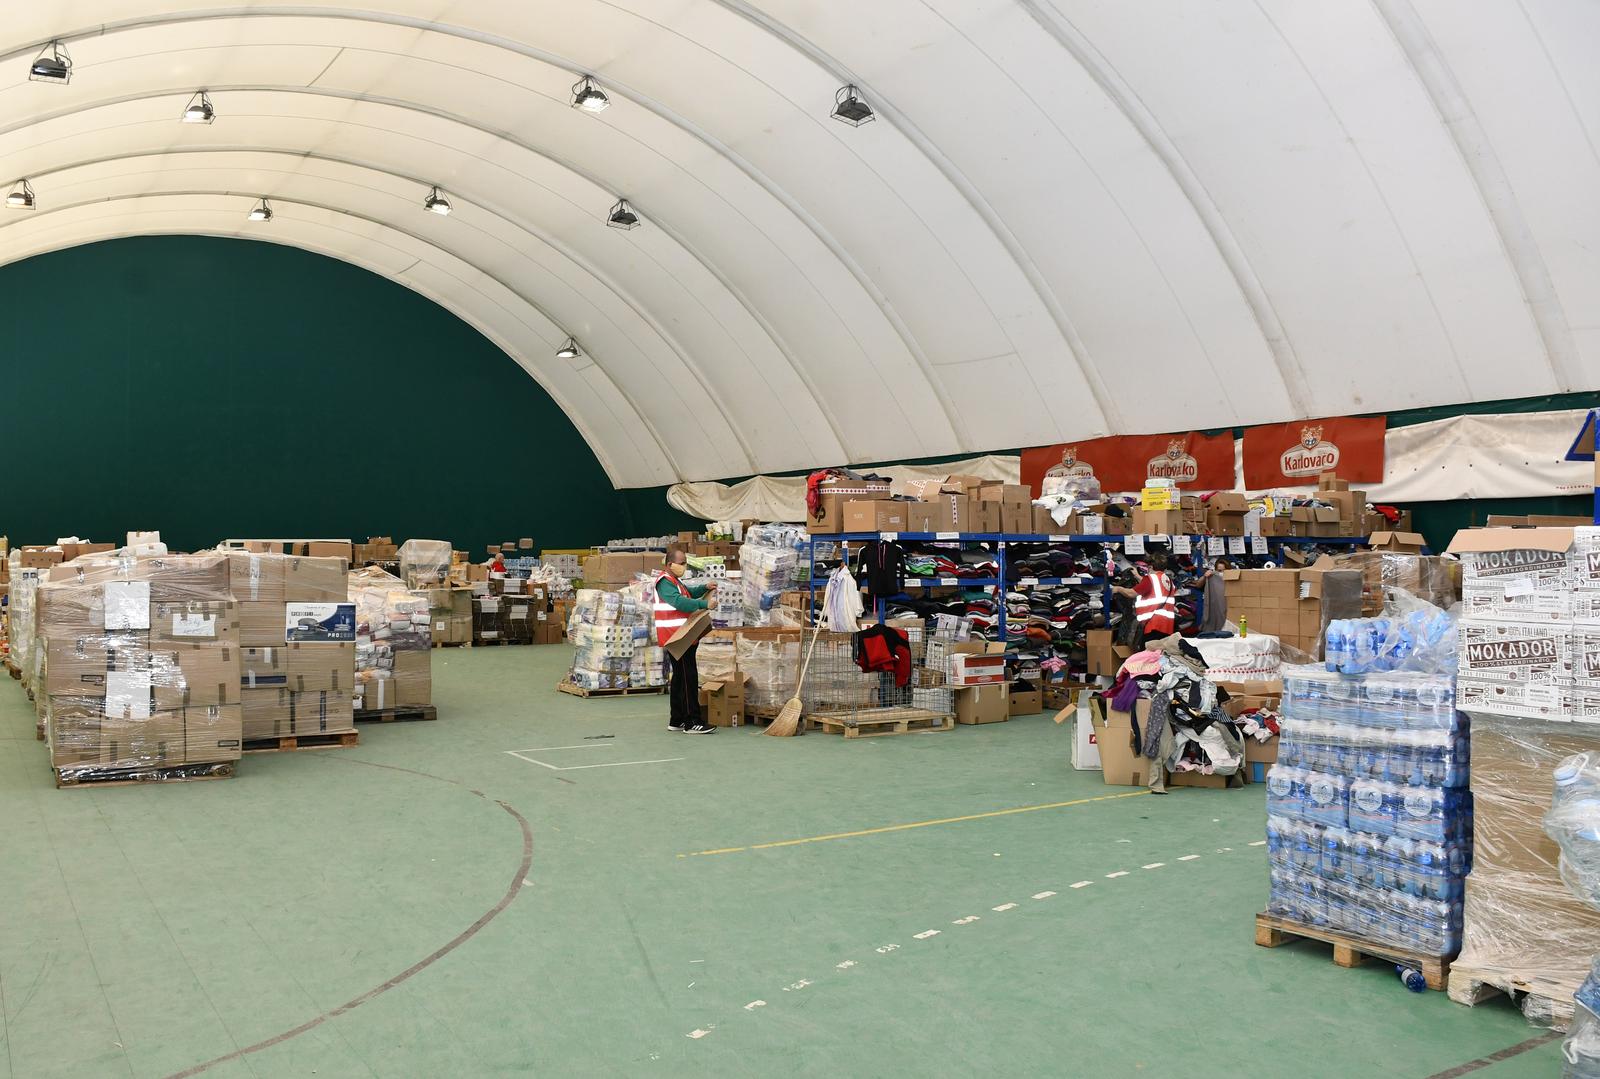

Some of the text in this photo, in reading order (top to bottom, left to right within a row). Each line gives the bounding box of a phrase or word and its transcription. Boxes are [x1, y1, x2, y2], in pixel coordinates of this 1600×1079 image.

[1149, 462, 1195, 477] Karlovako
[1539, 577, 1560, 586] 100%
[1470, 640, 1554, 661] MOKADOR
[1530, 672, 1551, 681] 100%
[1465, 697, 1484, 705] 100%
